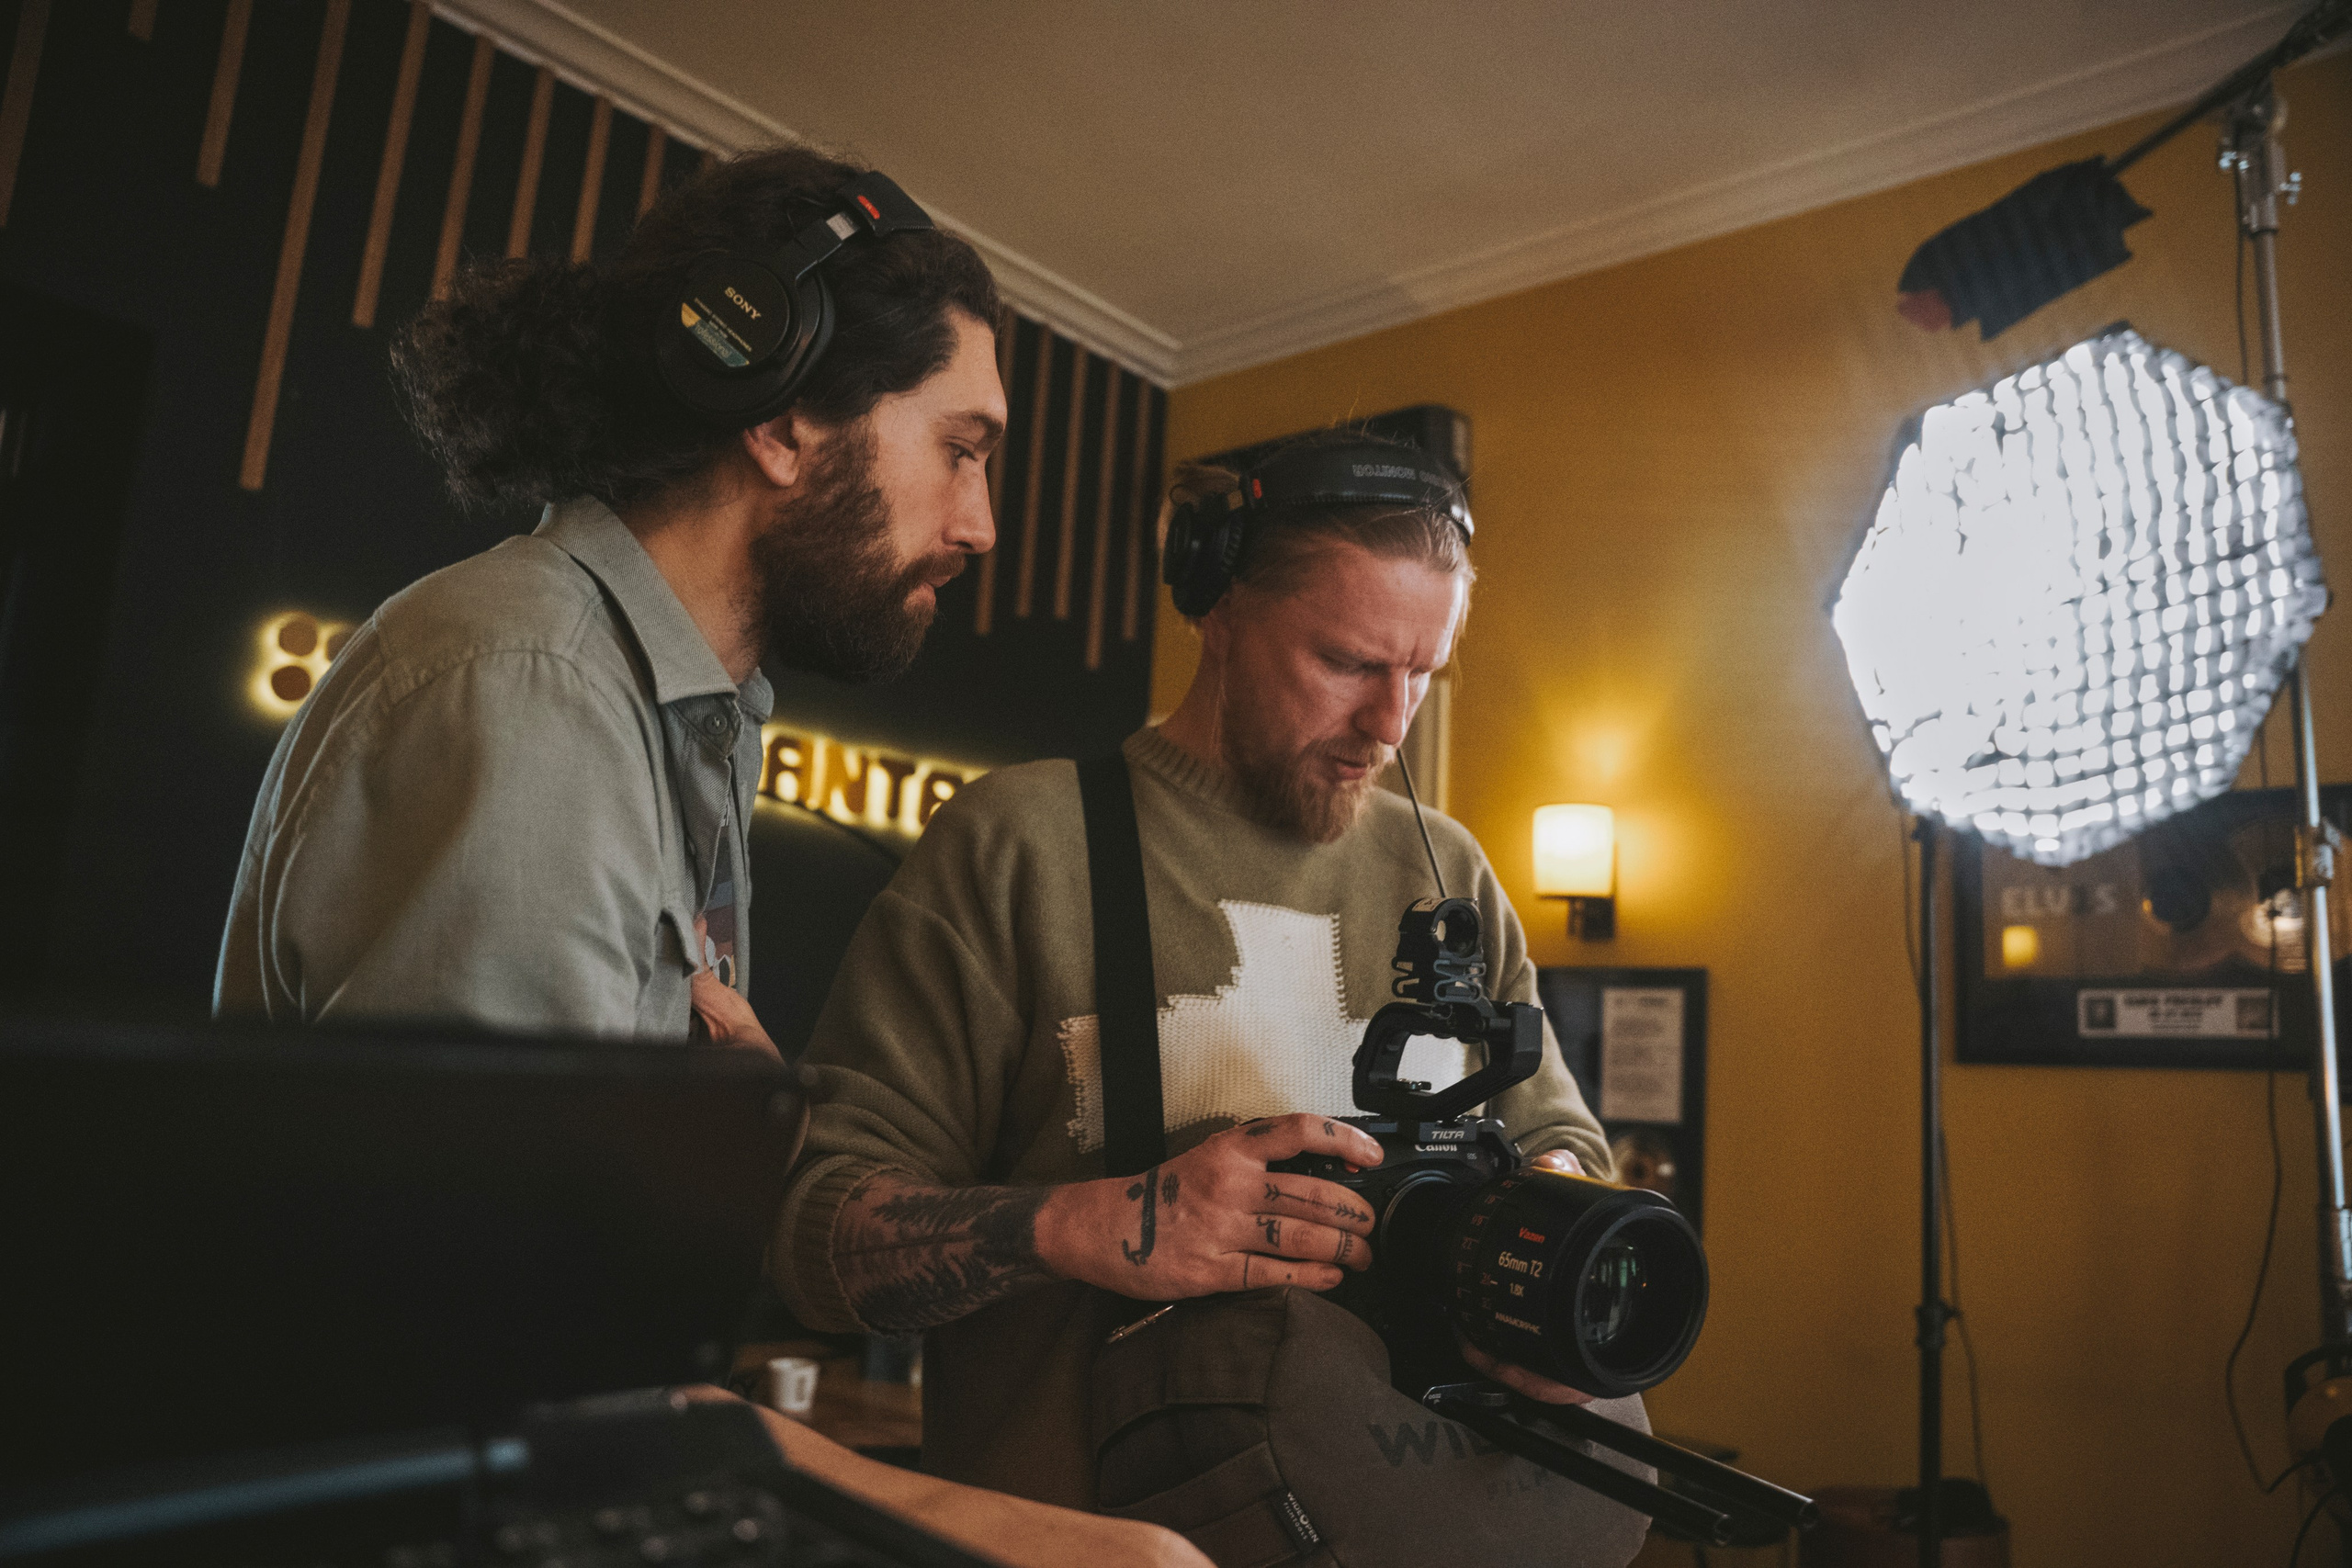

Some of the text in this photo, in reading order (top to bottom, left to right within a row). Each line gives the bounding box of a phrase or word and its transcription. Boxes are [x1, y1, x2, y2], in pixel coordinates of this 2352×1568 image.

[724, 286, 761, 320] SONY
[1431, 1130, 1464, 1141] TILTA
[1519, 1226, 1545, 1244] Vazen
[1498, 1250, 1543, 1278] 65mm T2
